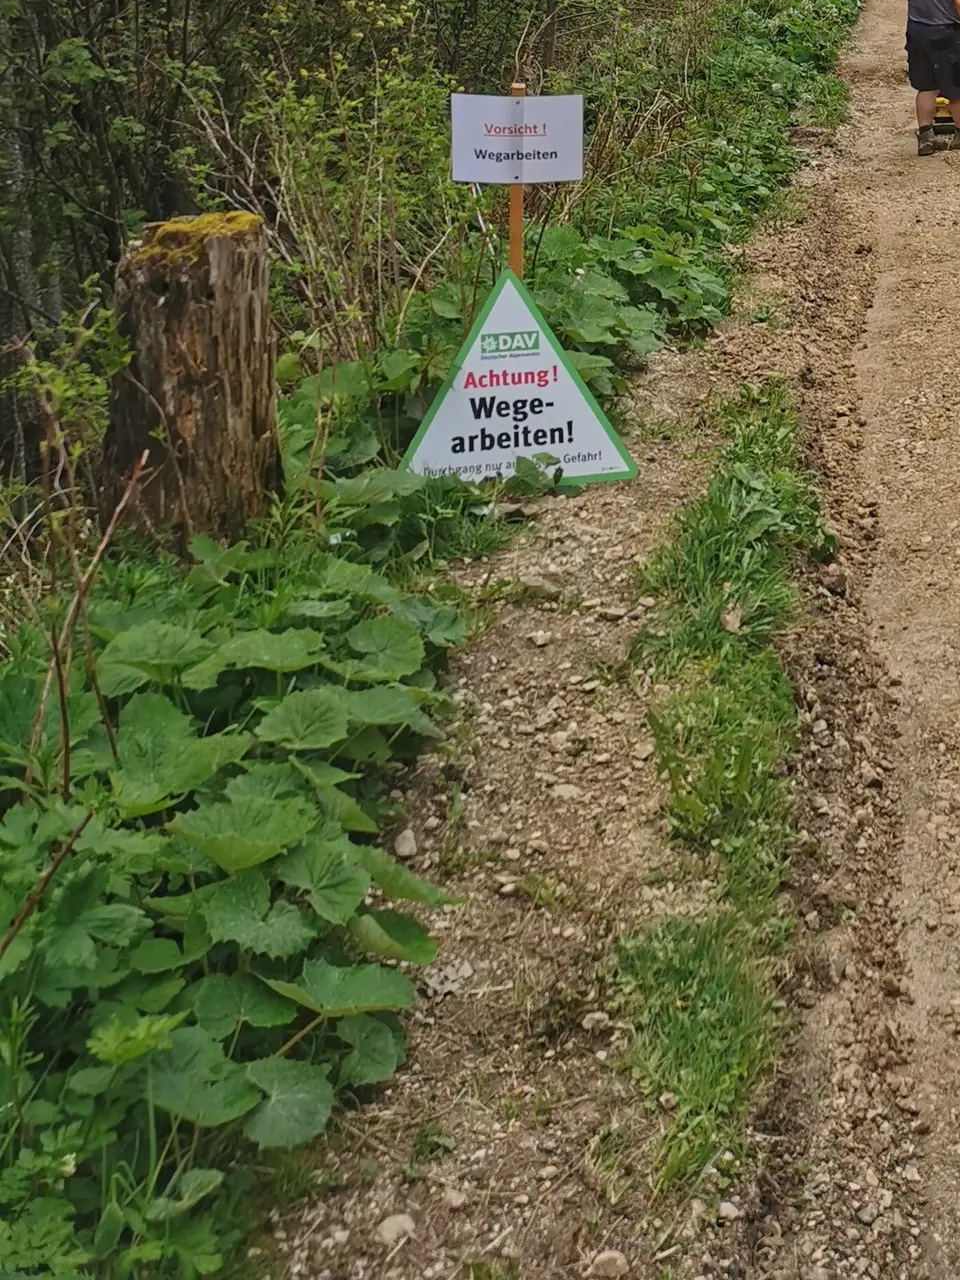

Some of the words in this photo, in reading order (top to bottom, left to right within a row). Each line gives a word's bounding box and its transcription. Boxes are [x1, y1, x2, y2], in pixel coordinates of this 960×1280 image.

[484, 123, 538, 135] Vorsicht
[474, 148, 558, 163] Wegarbeiten
[498, 332, 538, 351] DAV
[469, 395, 554, 422] Wege-
[450, 420, 574, 455] arbeiten!
[485, 461, 502, 472] nur
[563, 450, 602, 464] Gefahr!
